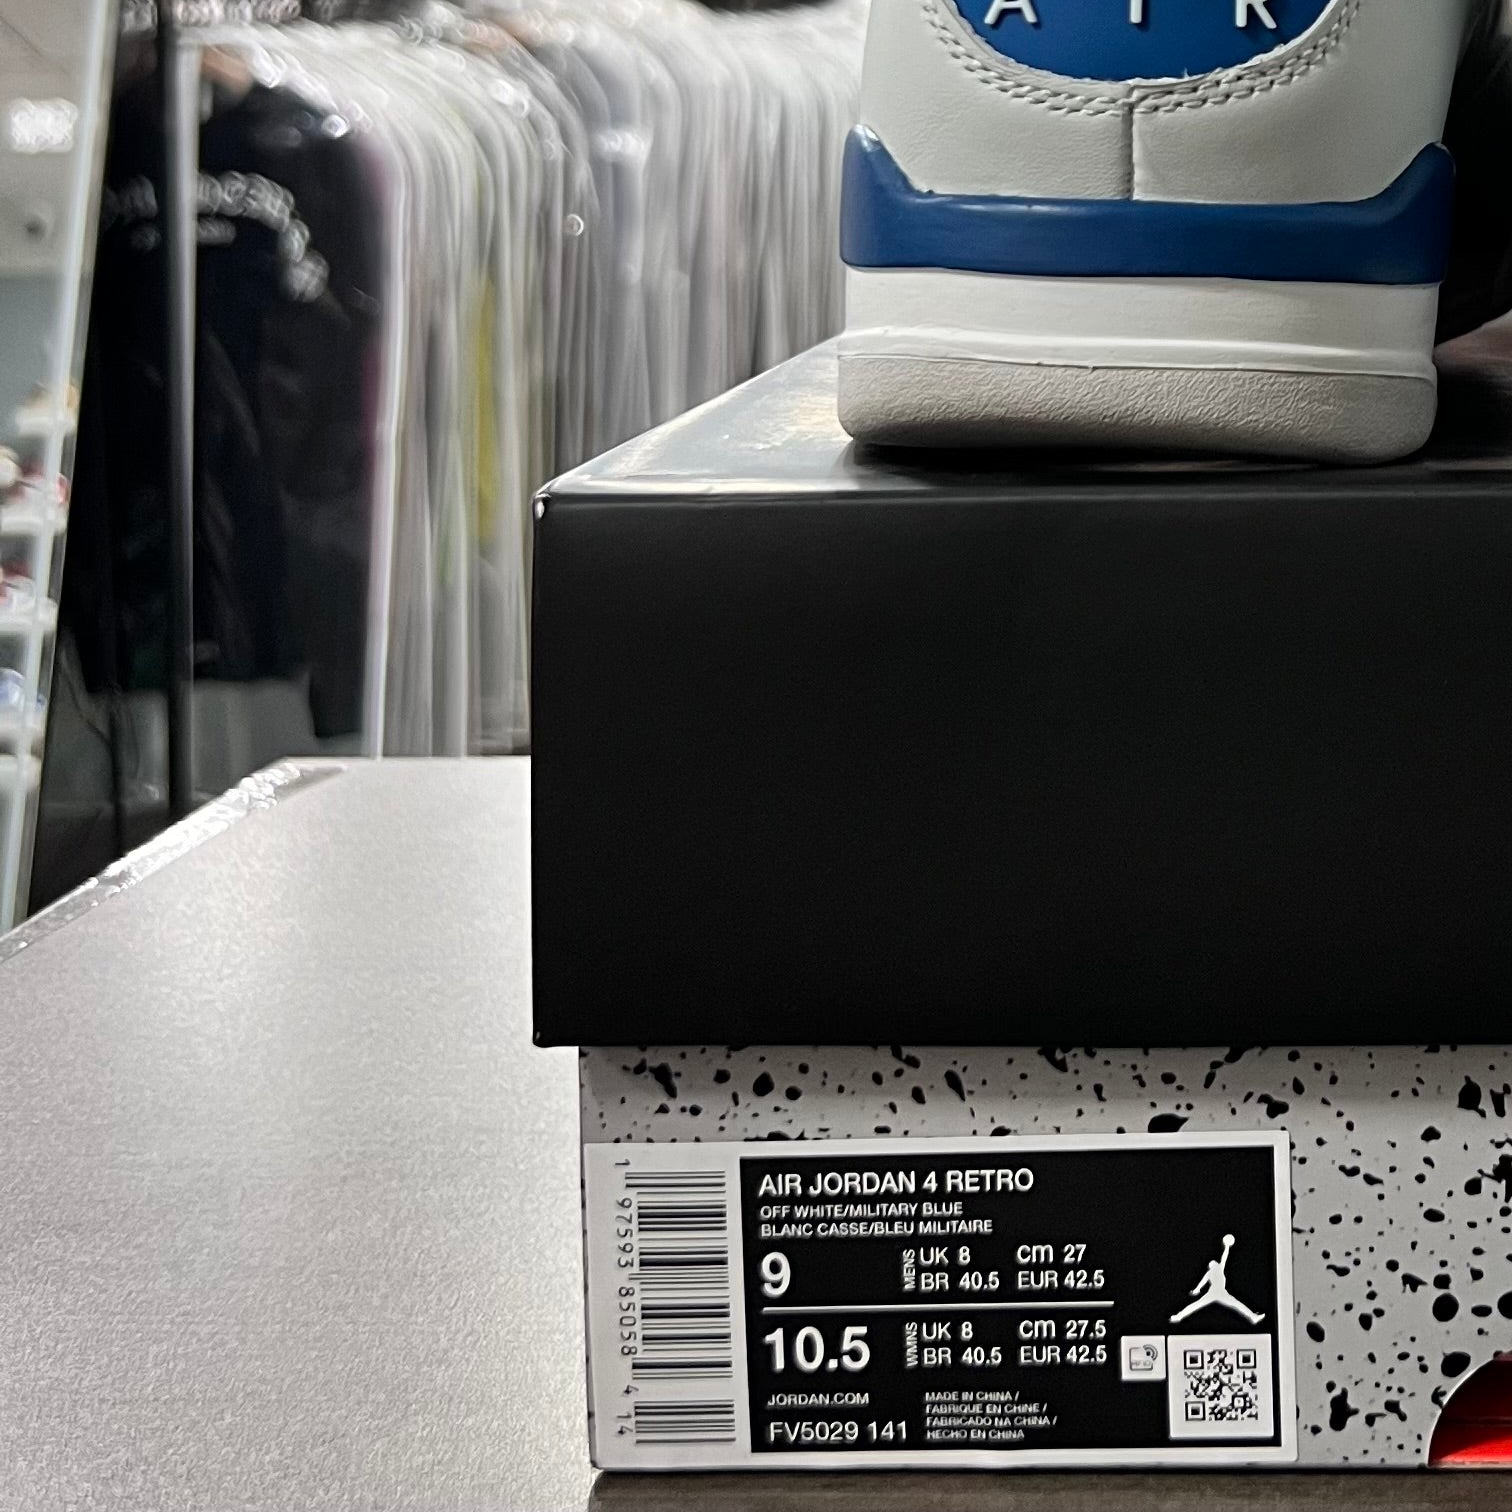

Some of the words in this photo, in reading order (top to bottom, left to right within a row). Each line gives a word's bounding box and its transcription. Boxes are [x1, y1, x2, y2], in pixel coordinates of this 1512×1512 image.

[758, 1173, 802, 1197] AIR
[809, 1171, 916, 1196] JORDAN
[922, 1171, 938, 1194] 4
[946, 1168, 1034, 1193] RETRO
[760, 1205, 790, 1220] OFF
[794, 1202, 918, 1219] WHITE/MILITARY
[922, 1201, 963, 1217] BLUE
[616, 1197, 634, 1268] 97593
[760, 1223, 813, 1238] BLANC
[817, 1221, 914, 1237] CASSE/BLEU
[919, 1219, 993, 1235] MILITAIRE
[919, 1247, 949, 1266] UK
[958, 1246, 971, 1265] 8
[1063, 1244, 1086, 1264] 27
[761, 1251, 791, 1299] 9
[903, 1249, 915, 1289] MENS
[1018, 1270, 1058, 1289] EUR
[1064, 1269, 1104, 1288] 42.5
[921, 1273, 949, 1291] BR
[959, 1271, 999, 1291] 40.5
[618, 1286, 638, 1356] 85058
[1066, 1319, 1106, 1338] 27.5
[922, 1322, 951, 1341] UK
[961, 1322, 973, 1341] 8
[764, 1326, 871, 1371] 10.5
[906, 1322, 918, 1367] WMNS
[1020, 1346, 1060, 1364] EUR
[1066, 1345, 1107, 1363] 42.5
[924, 1348, 951, 1365] BR
[962, 1347, 1002, 1366] 40.5
[767, 1392, 869, 1407] JORDAN.COM
[925, 1392, 959, 1402] MADE
[976, 1391, 1012, 1402] CHINA
[925, 1404, 983, 1414] FABRIQUE
[986, 1404, 1001, 1414] EN
[1004, 1403, 1040, 1414] CHINE
[769, 1421, 859, 1442] FV5029
[867, 1420, 907, 1441] 141
[926, 1417, 992, 1427] FABRICADO
[994, 1417, 1011, 1426] NA
[1014, 1416, 1050, 1426] CHINA
[926, 1429, 967, 1440] HECHO
[970, 1429, 986, 1439] EN
[988, 1429, 1025, 1440] CHINA
